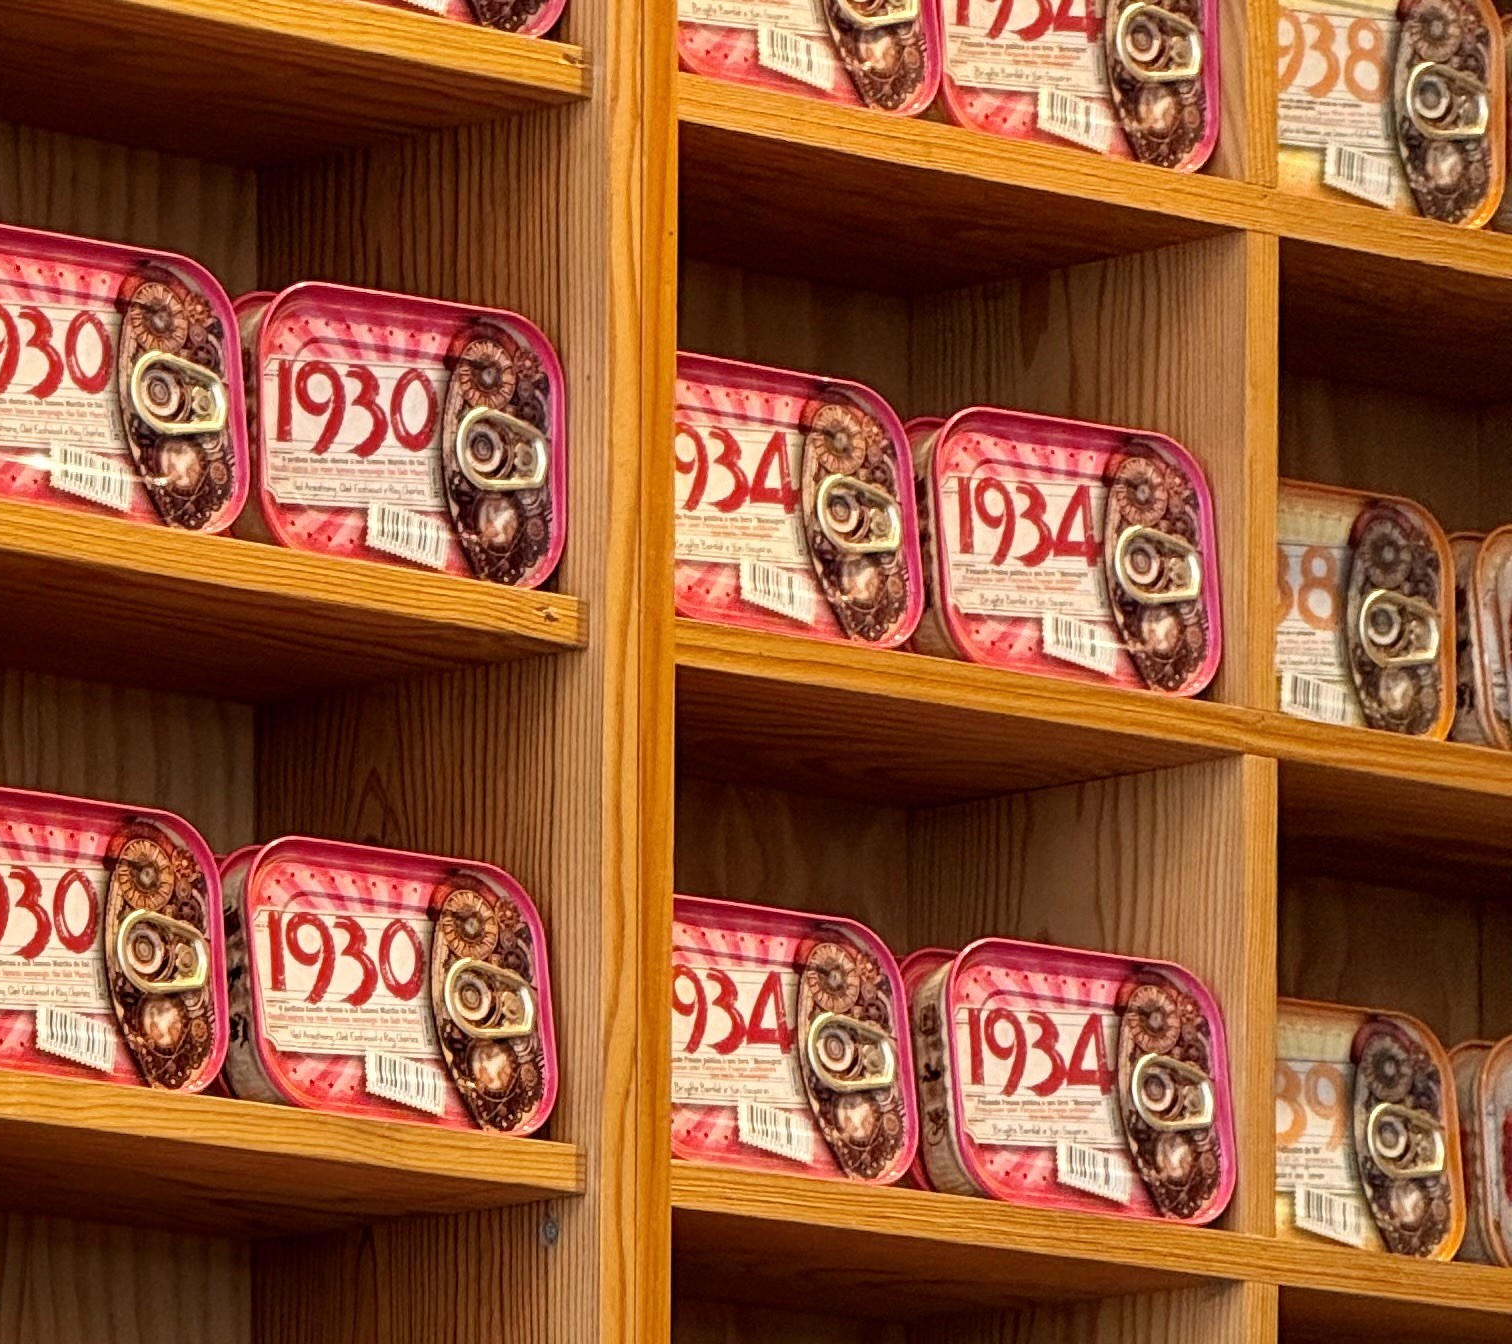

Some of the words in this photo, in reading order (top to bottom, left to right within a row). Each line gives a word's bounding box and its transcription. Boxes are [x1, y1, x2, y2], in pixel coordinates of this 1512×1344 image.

[1278, 8, 1384, 104] 38
[275, 358, 439, 458] 1930
[675, 420, 801, 514] 934
[956, 476, 1104, 568] 1934
[266, 909, 425, 1008] 1930
[672, 962, 794, 1055] 934
[968, 1006, 1117, 1098] 1934
[1276, 1059, 1346, 1150] 39
